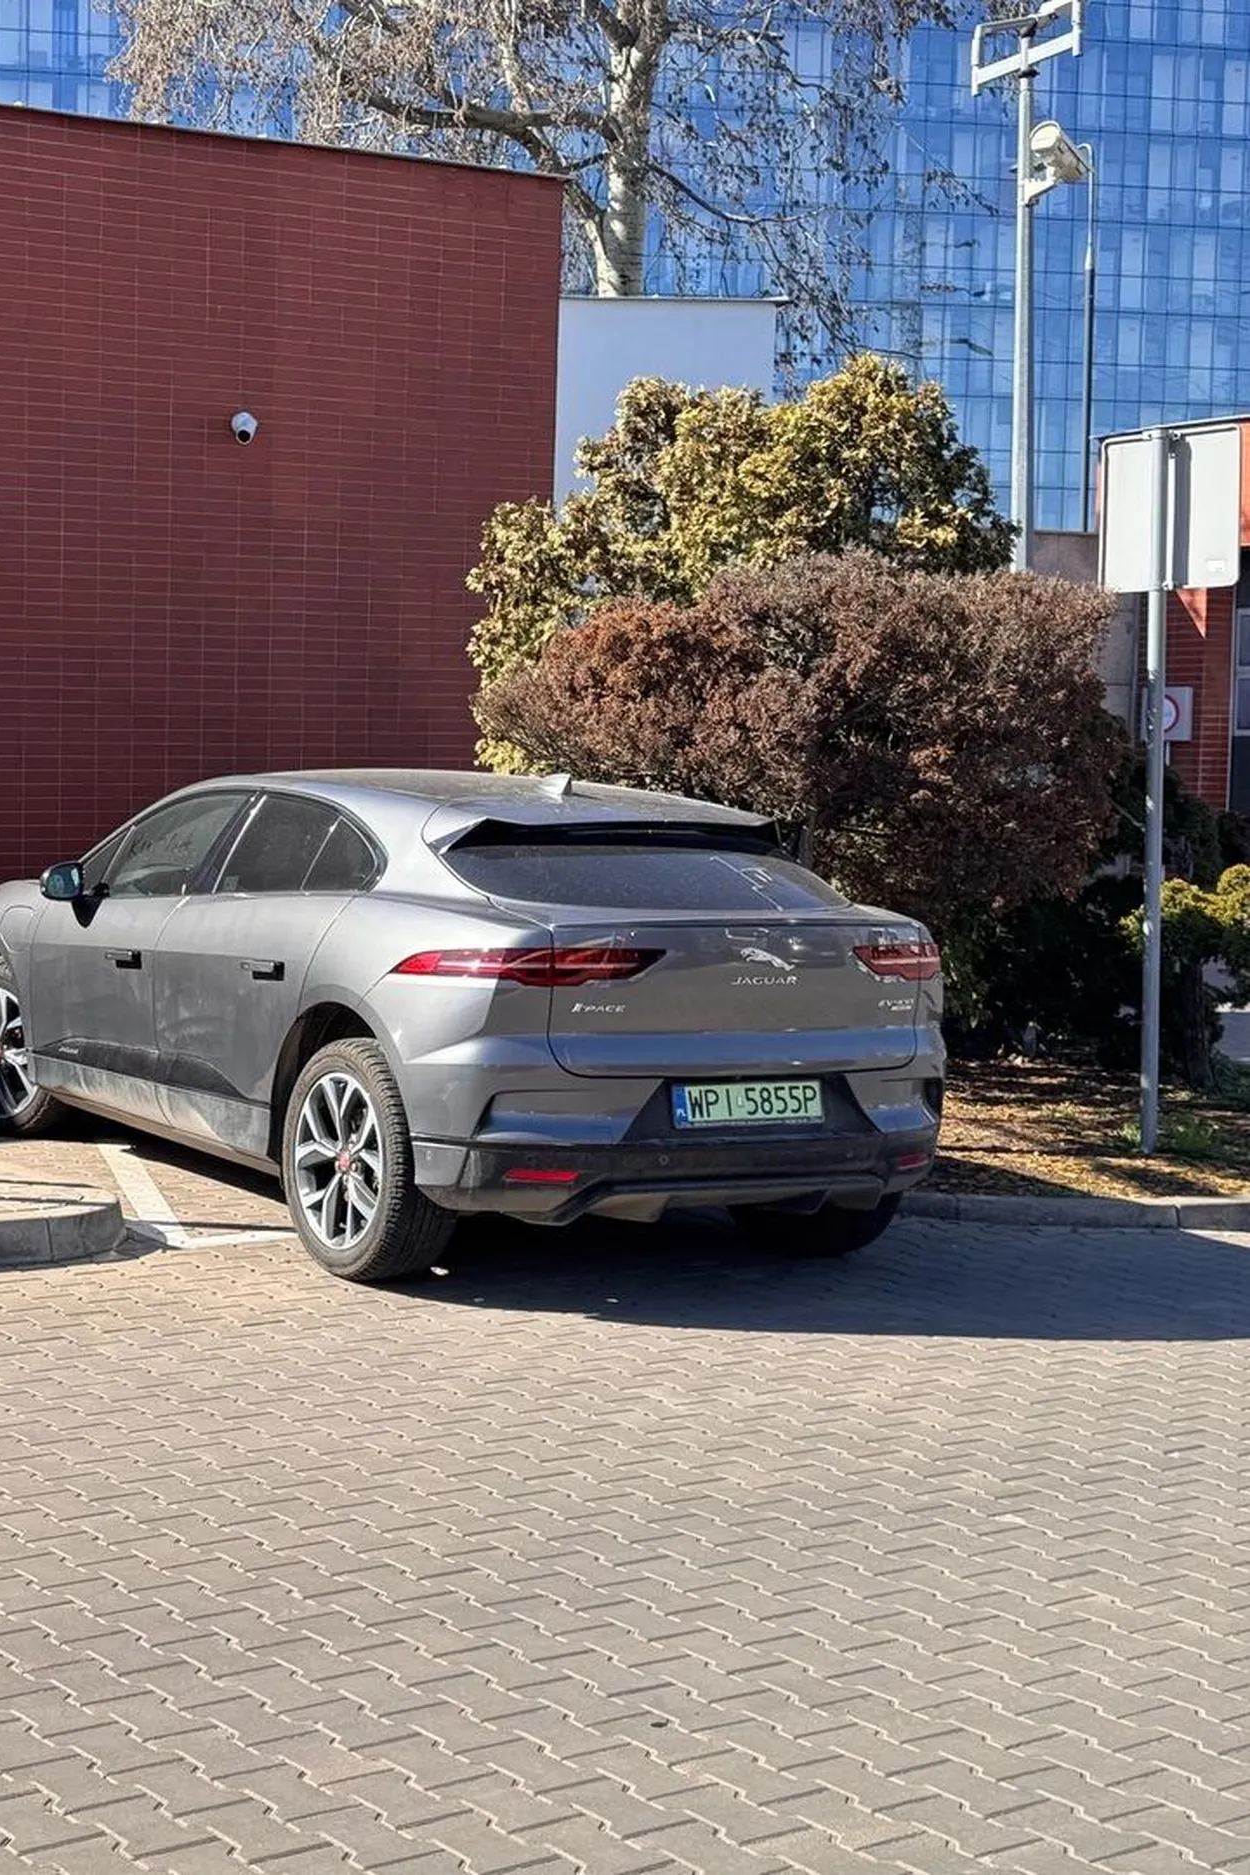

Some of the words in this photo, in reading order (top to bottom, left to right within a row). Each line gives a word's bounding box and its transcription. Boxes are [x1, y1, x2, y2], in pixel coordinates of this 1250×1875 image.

[730, 975, 798, 985] JAGUAR
[687, 1088, 733, 1119] WPI
[744, 1085, 817, 1116] 5855P
